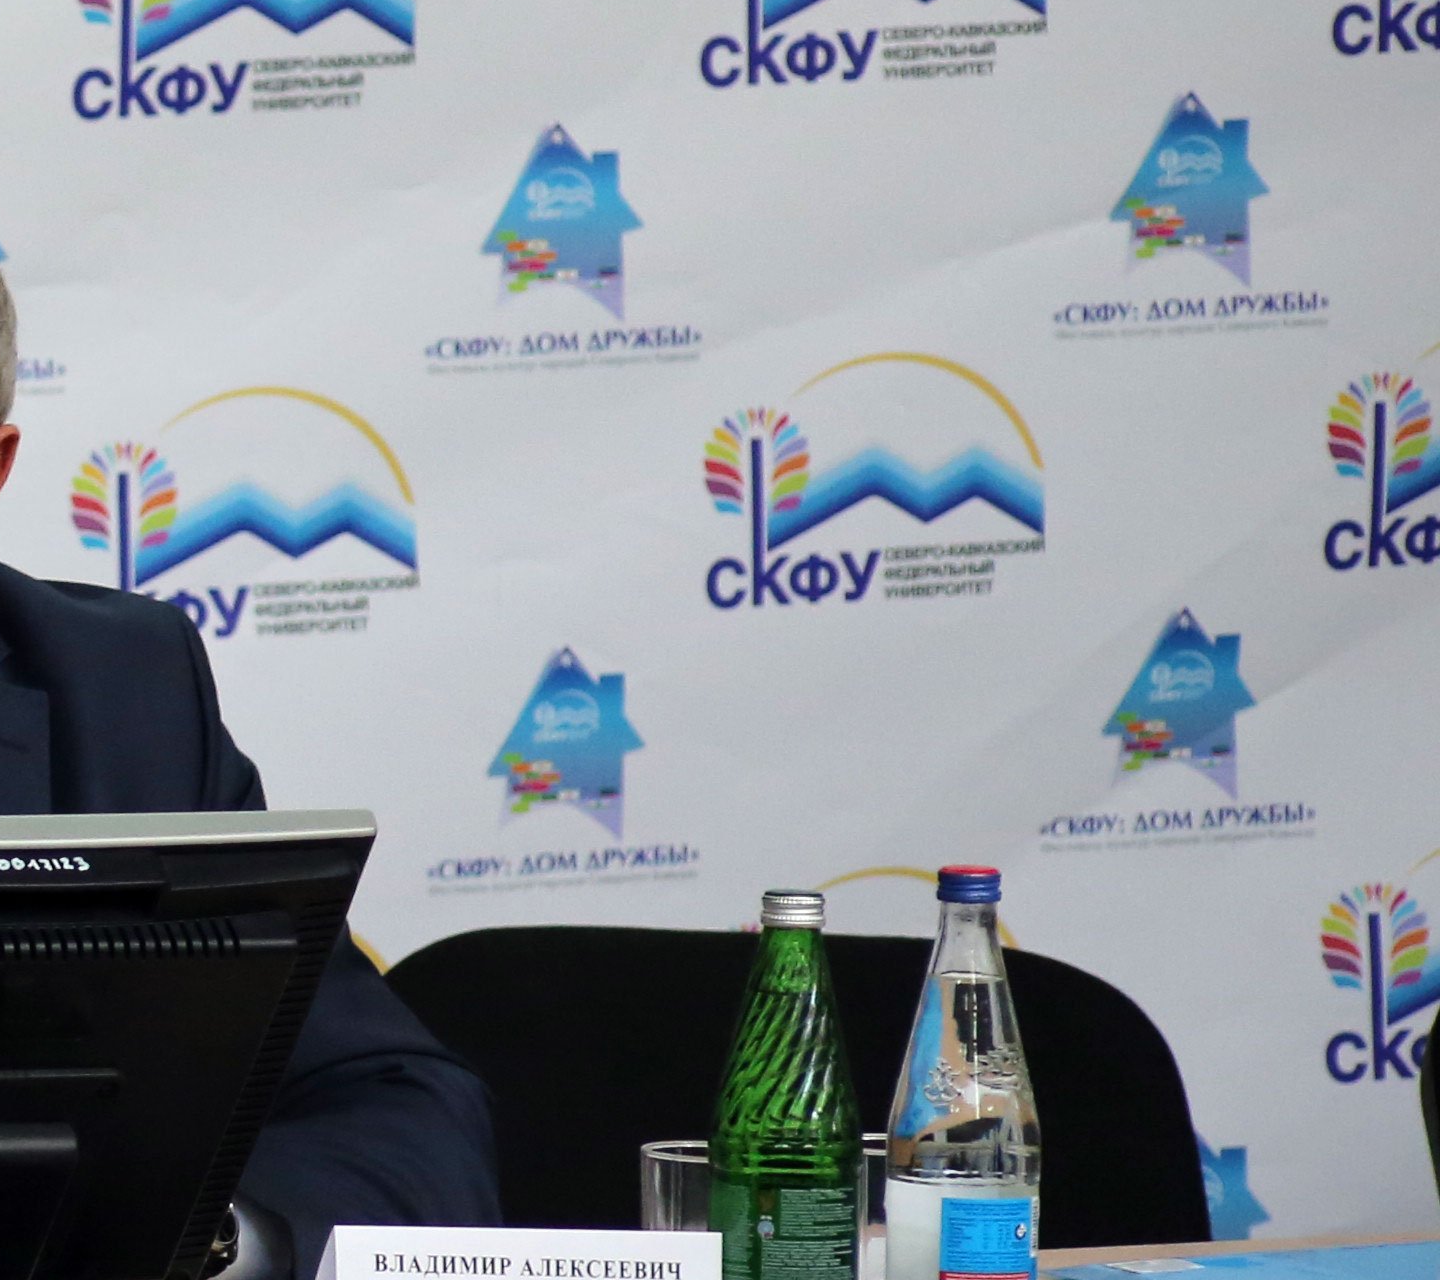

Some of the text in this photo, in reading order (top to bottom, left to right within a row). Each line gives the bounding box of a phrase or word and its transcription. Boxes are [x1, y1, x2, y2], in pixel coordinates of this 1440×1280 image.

[700, 29, 879, 90] СКФУ
[72, 64, 247, 122] СКФУ
[1145, 297, 1206, 323] ДОМ
[516, 330, 579, 357] ДОМ
[1323, 515, 1440, 570] СКФ
[706, 549, 882, 611] СКФУ
[1134, 808, 1193, 835] ДОМ
[517, 850, 578, 877] ДОМ
[373, 1252, 513, 1279] ВЛАДИМИР
